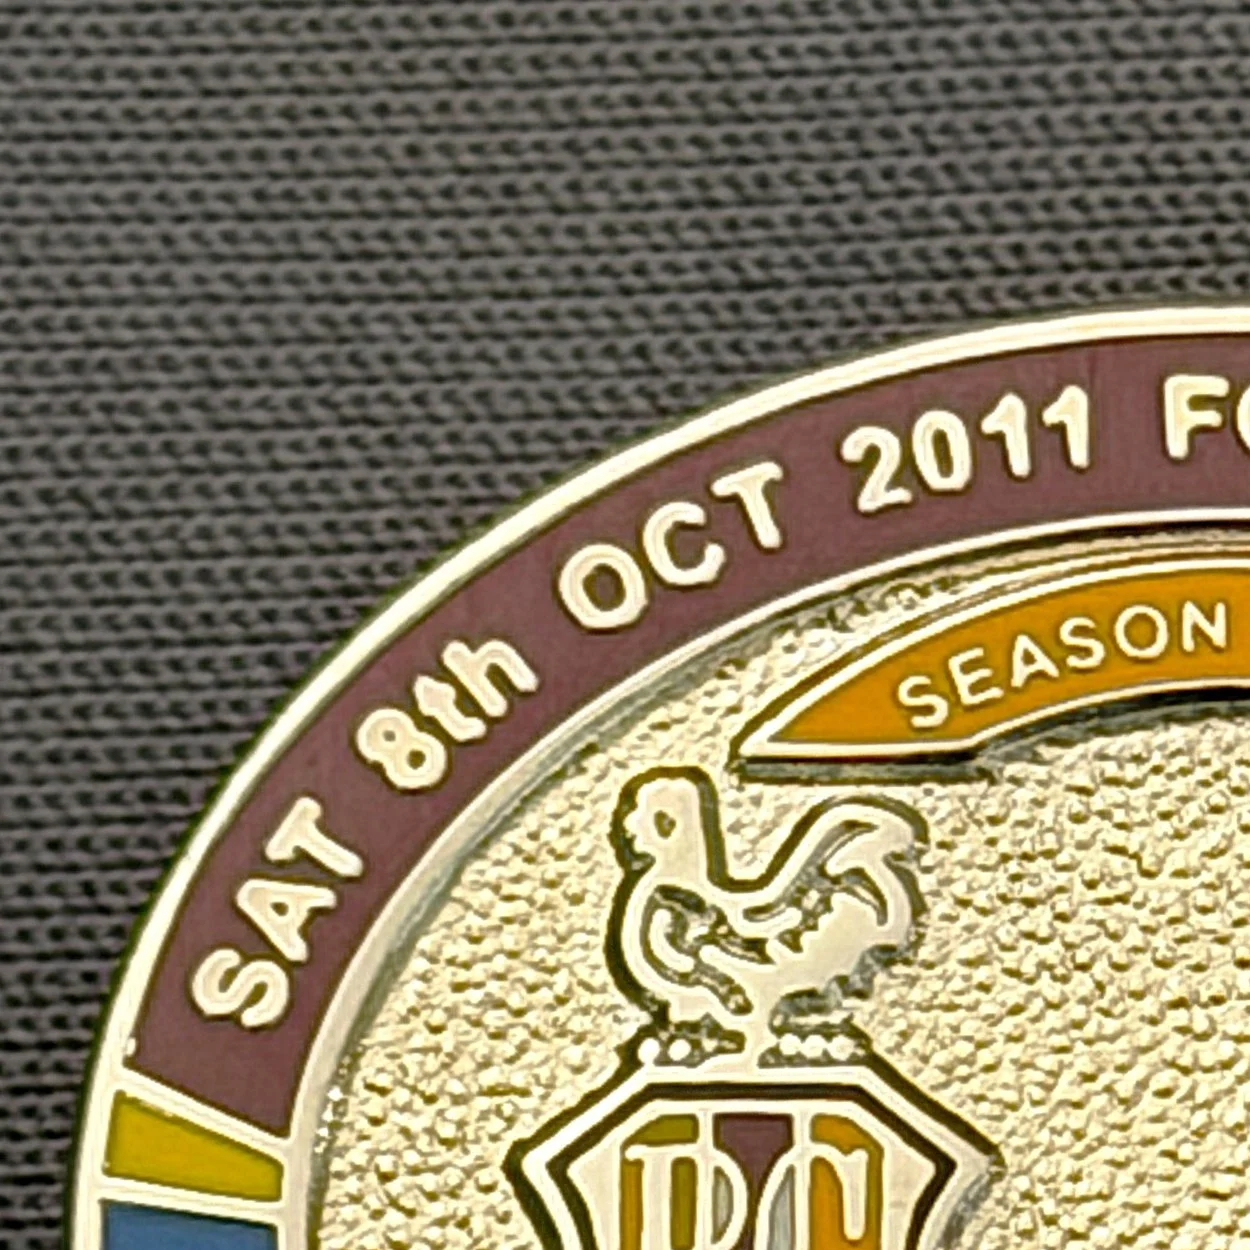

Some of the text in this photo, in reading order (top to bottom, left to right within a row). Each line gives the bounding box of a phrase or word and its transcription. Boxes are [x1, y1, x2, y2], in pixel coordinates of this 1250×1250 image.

[192, 796, 364, 1028] SAT
[355, 635, 539, 792] 8th
[557, 461, 785, 630] OCT
[841, 384, 1092, 513] 2011
[895, 600, 1228, 730] SEASON
